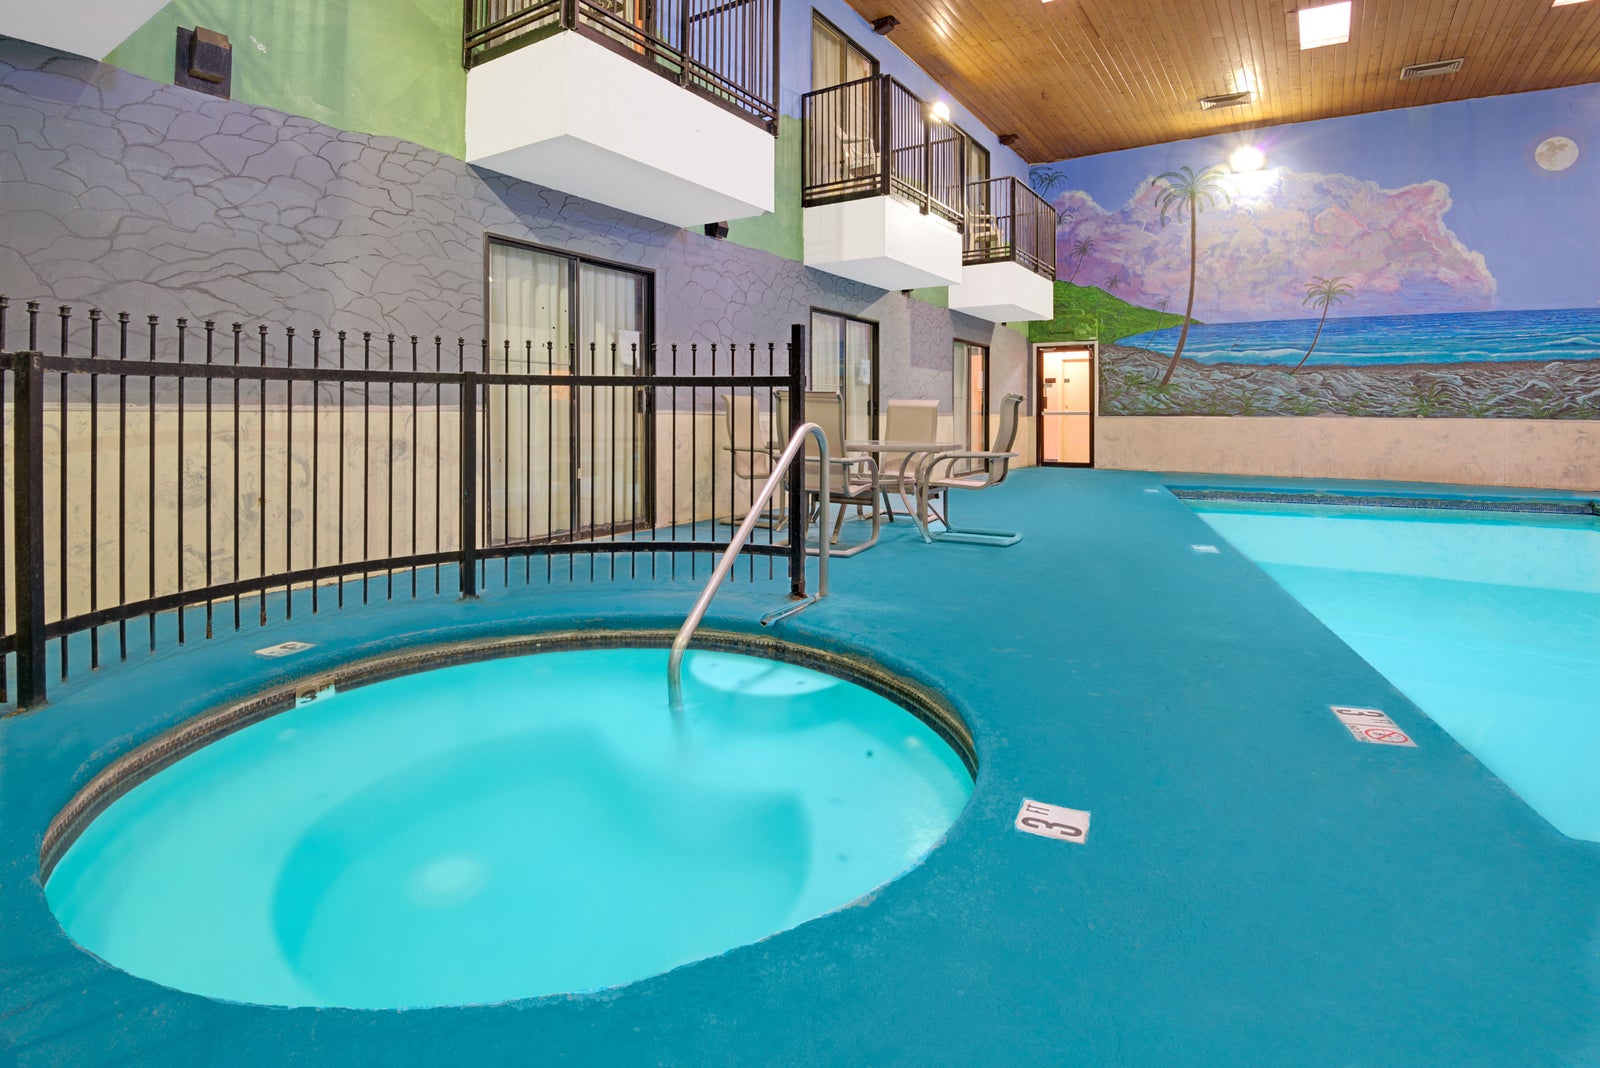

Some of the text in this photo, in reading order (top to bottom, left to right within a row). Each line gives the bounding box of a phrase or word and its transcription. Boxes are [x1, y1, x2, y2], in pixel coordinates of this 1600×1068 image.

[300, 689, 317, 704] 3
[1336, 709, 1384, 717] 3
[1021, 804, 1082, 837] 3 FT
